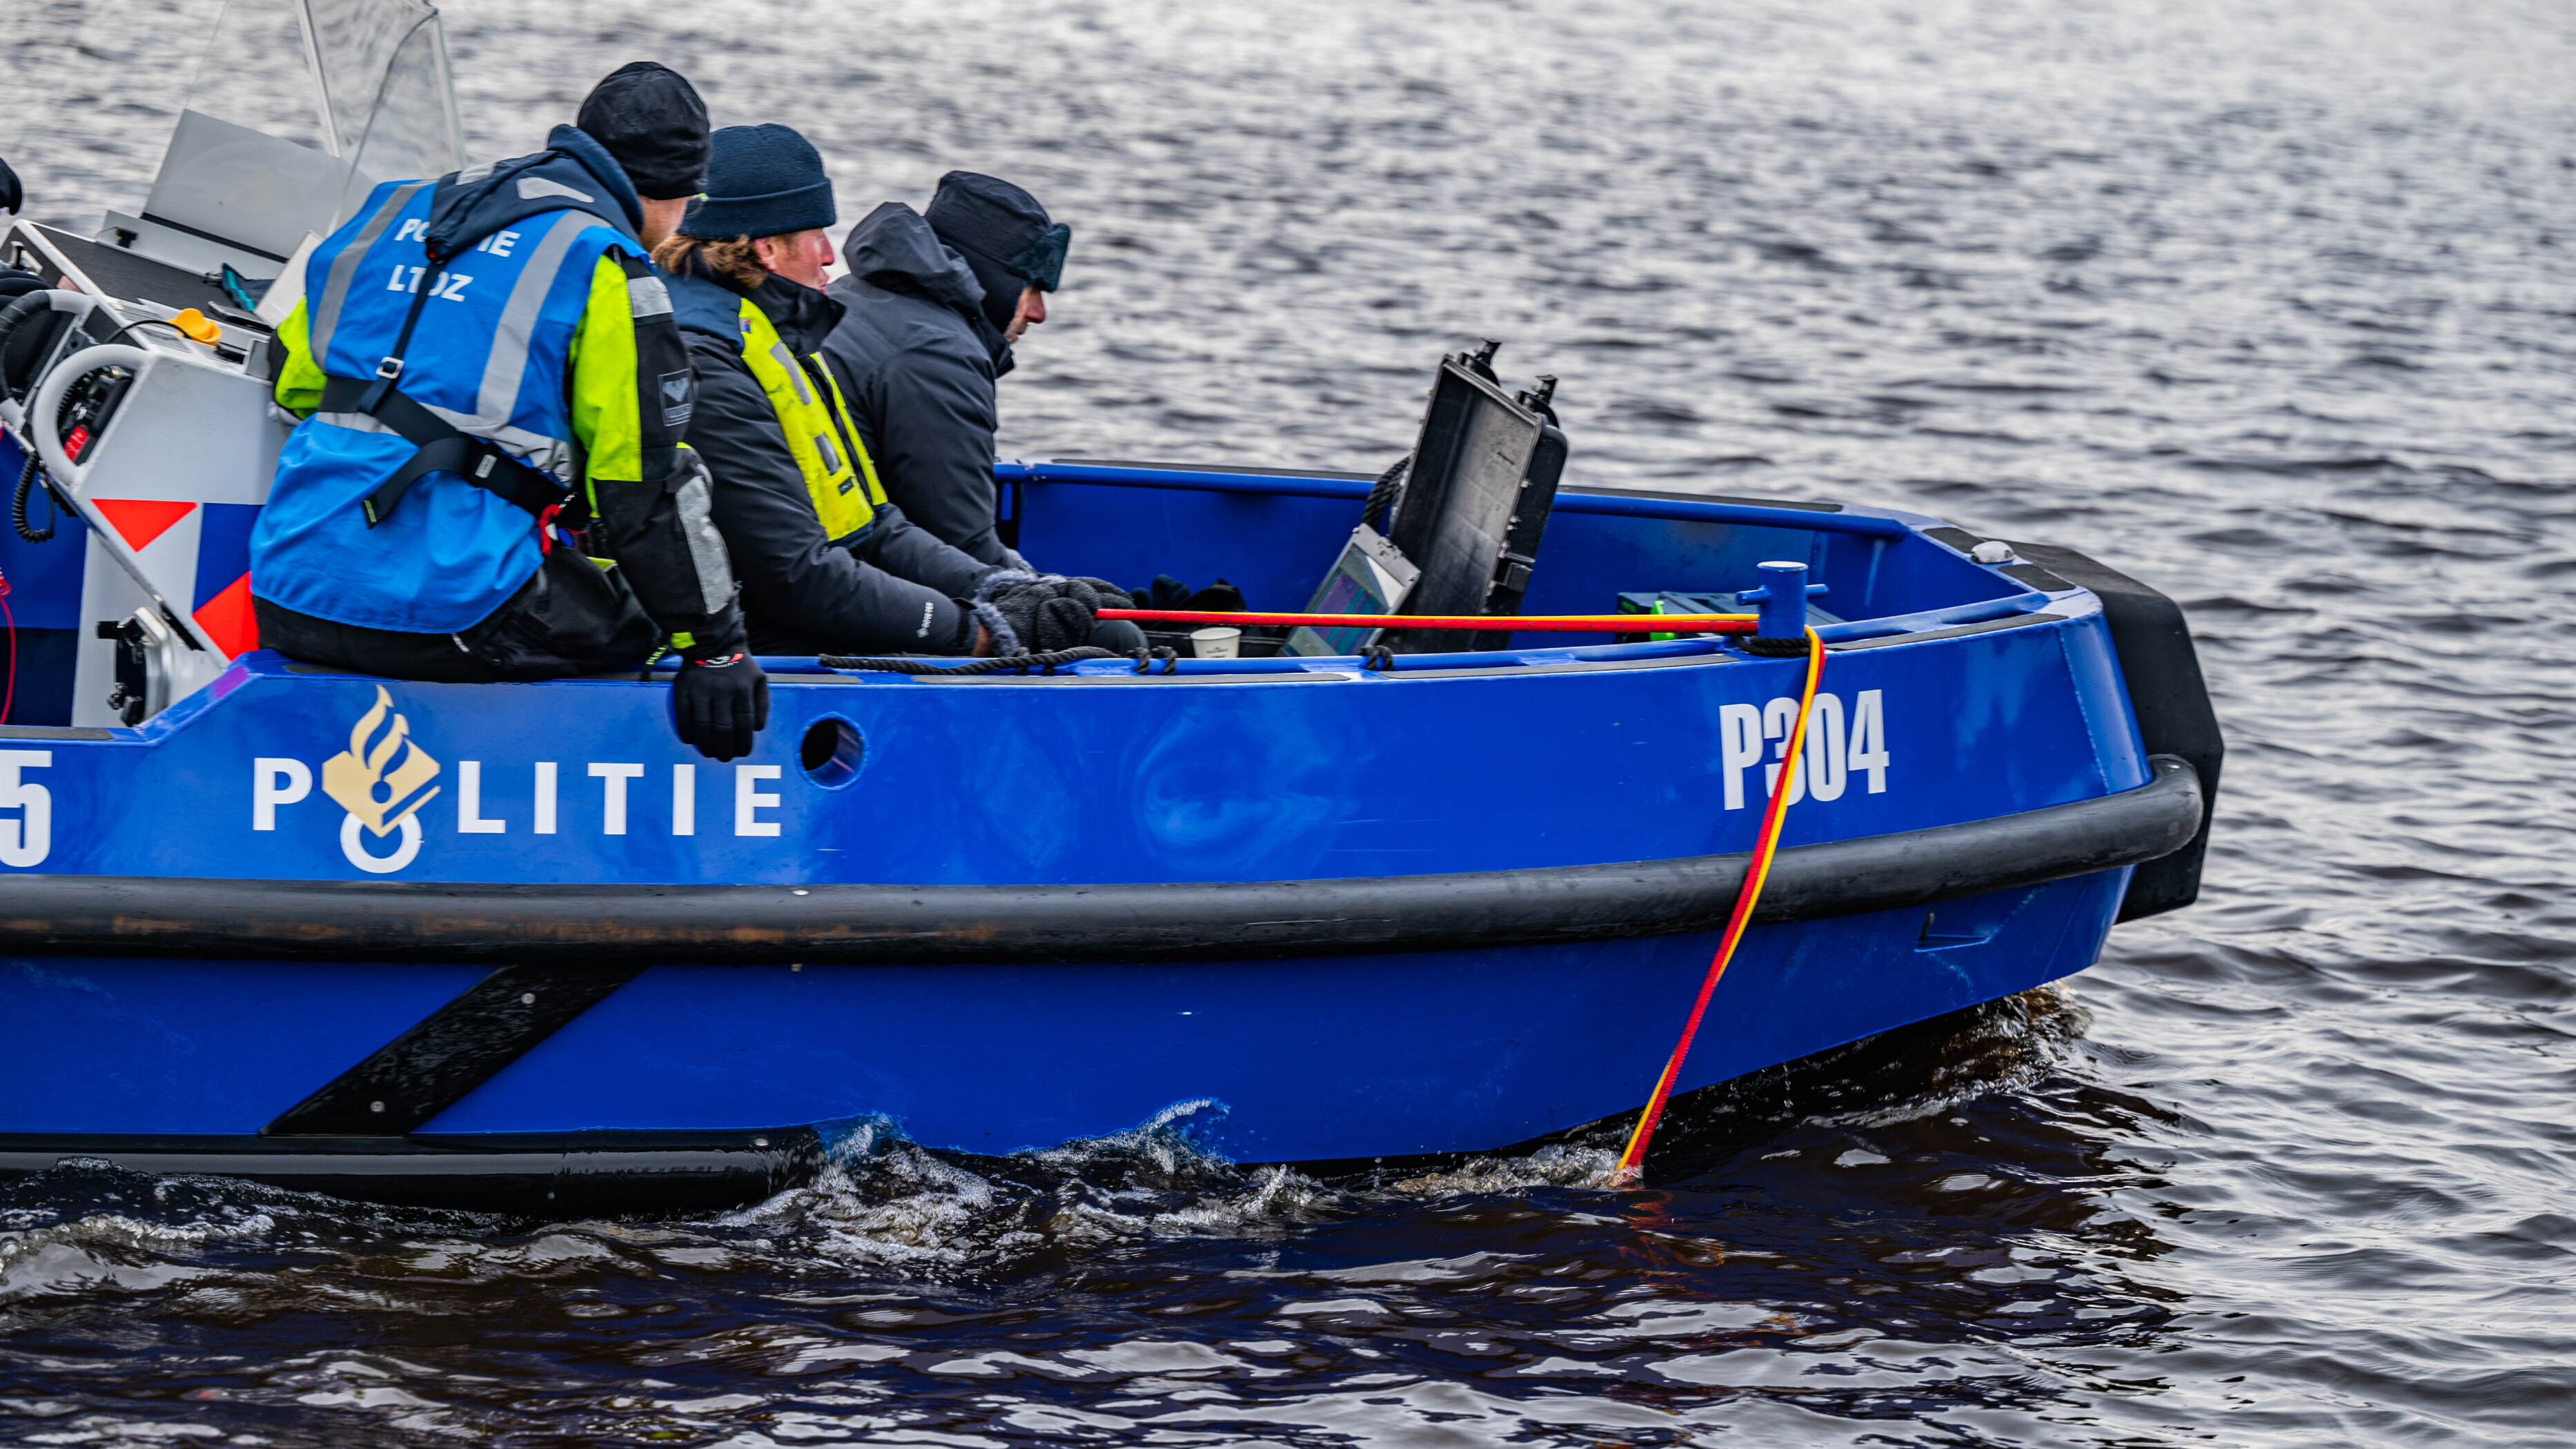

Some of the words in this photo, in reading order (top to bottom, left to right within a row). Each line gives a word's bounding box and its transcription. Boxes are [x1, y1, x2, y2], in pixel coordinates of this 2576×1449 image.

[394, 219, 521, 257] POIE
[0, 749, 52, 867] 5
[1719, 689, 1890, 811] P304
[253, 757, 782, 874] POLITIE
